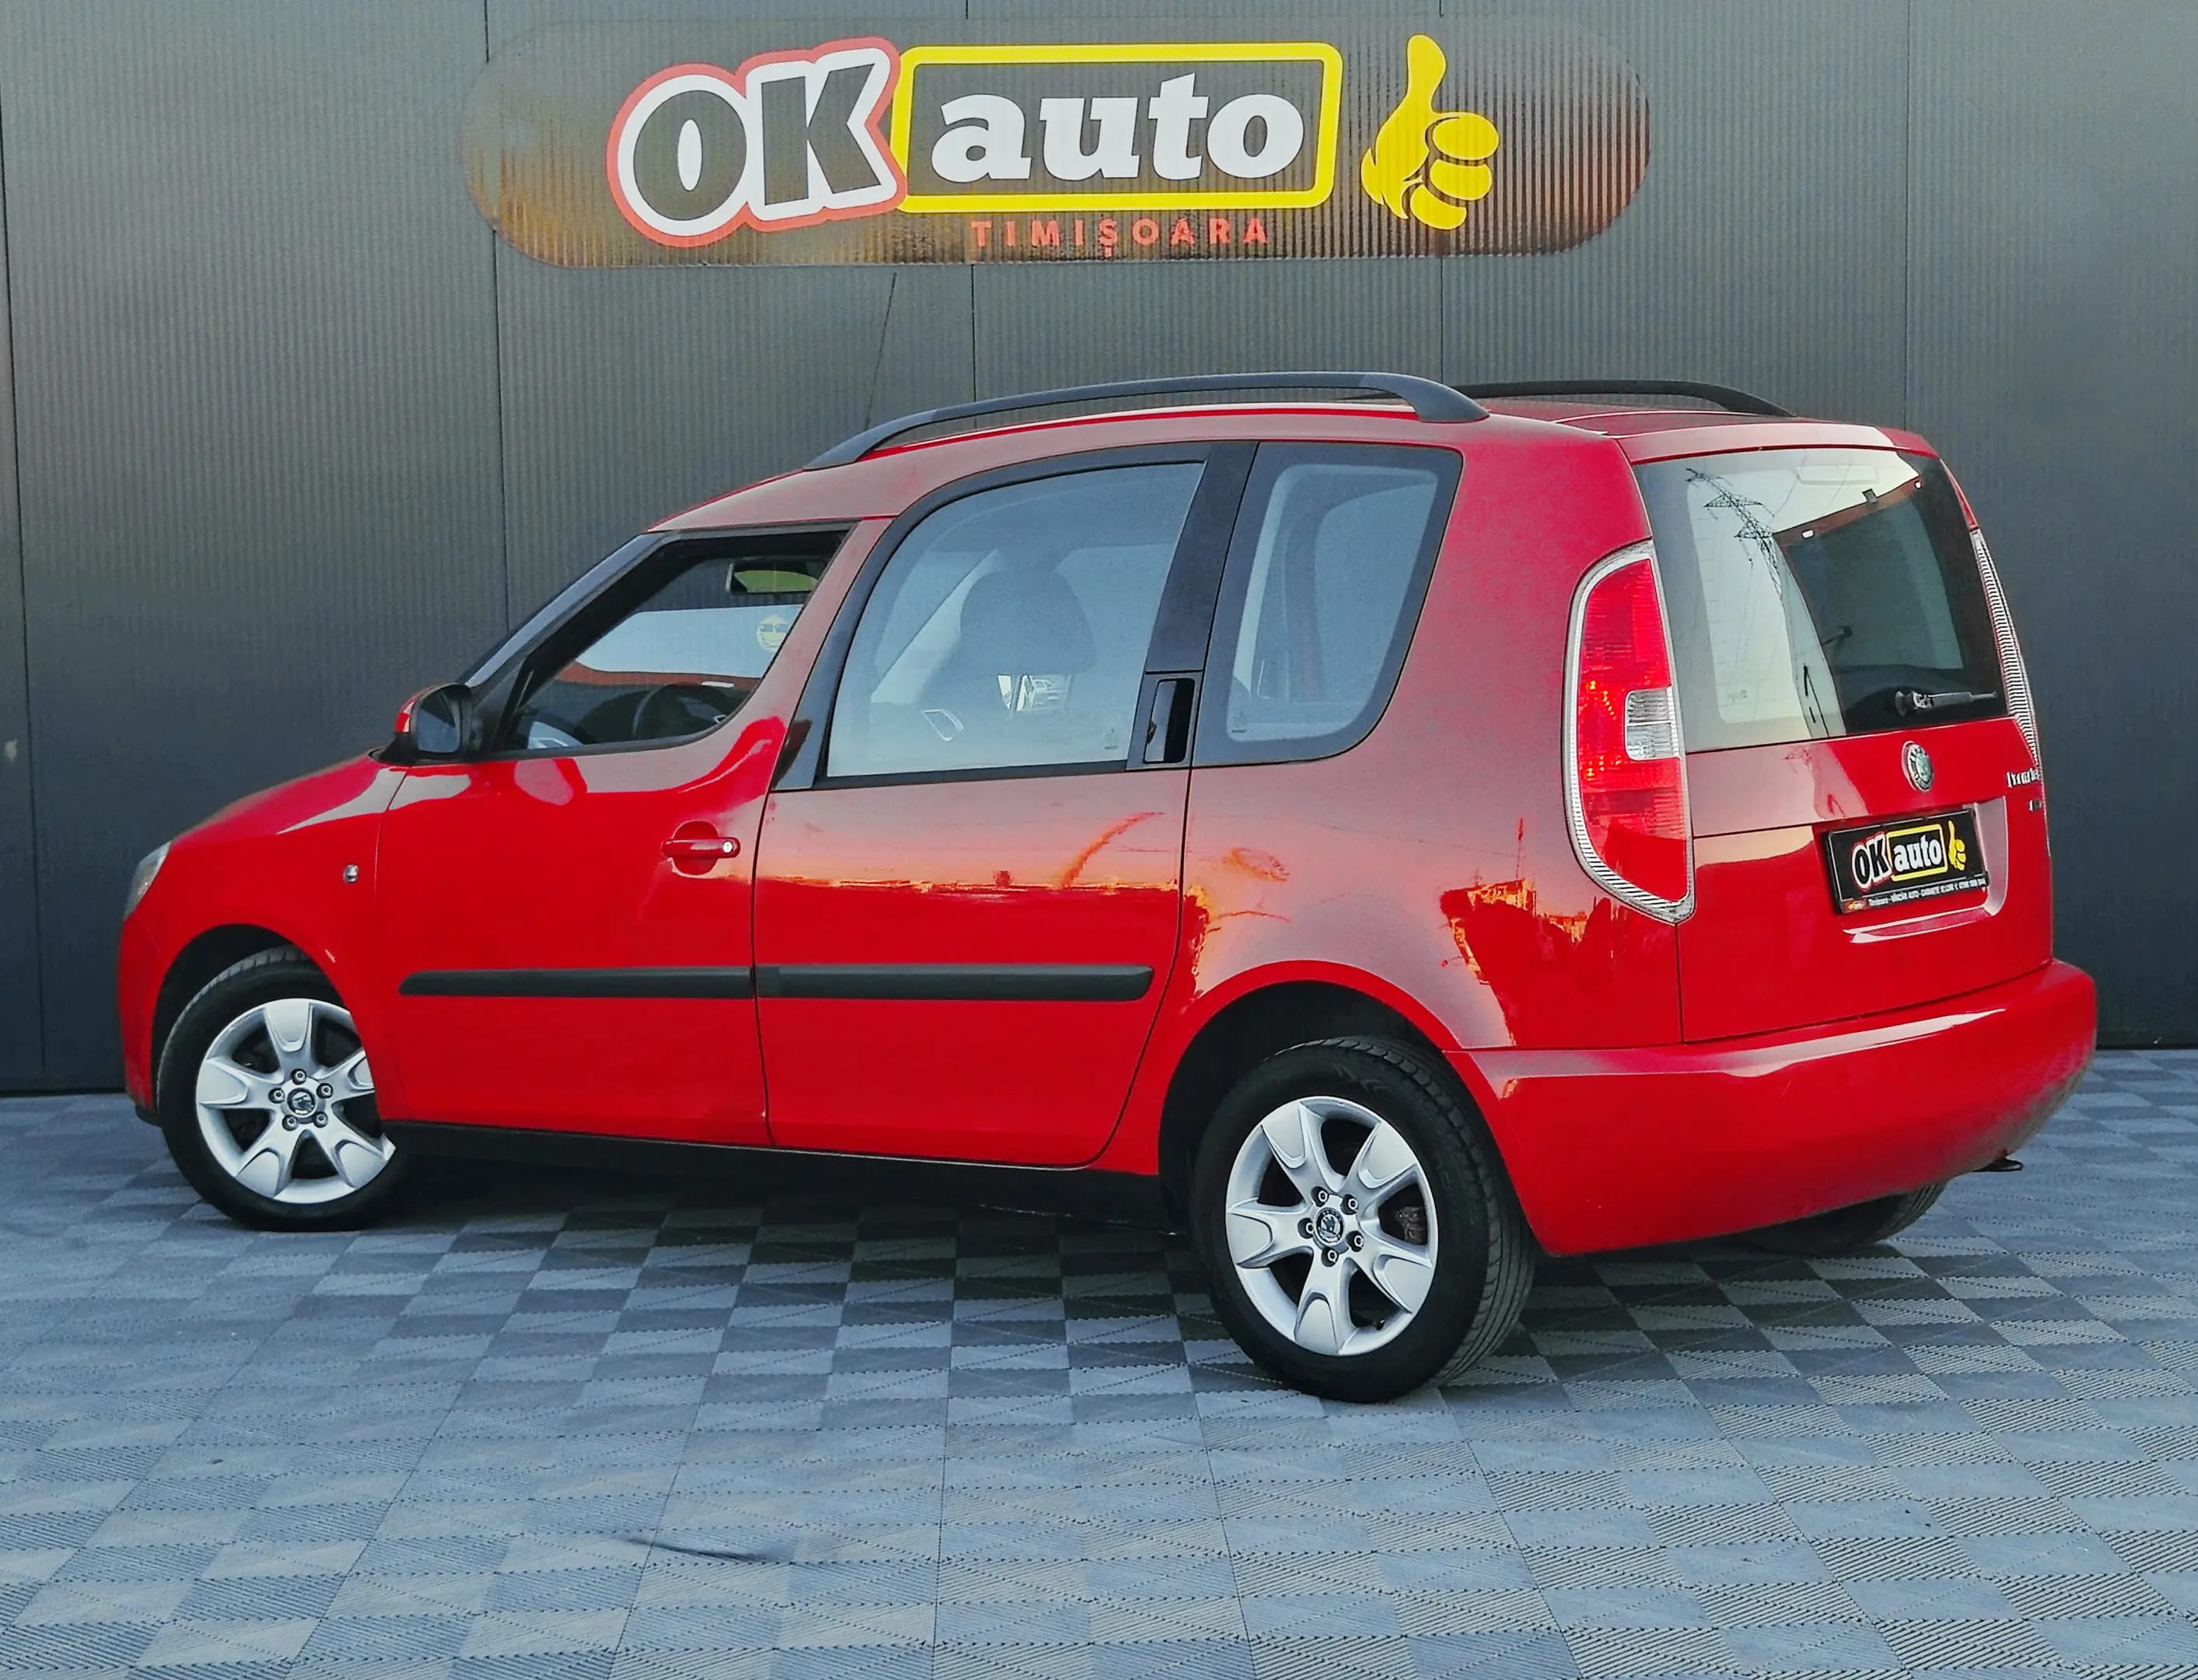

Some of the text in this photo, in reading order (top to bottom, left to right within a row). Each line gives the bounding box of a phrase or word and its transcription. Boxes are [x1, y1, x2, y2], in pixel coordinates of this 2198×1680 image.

[632, 62, 1305, 221] OK auto
[1854, 835, 1943, 885] OK auto
